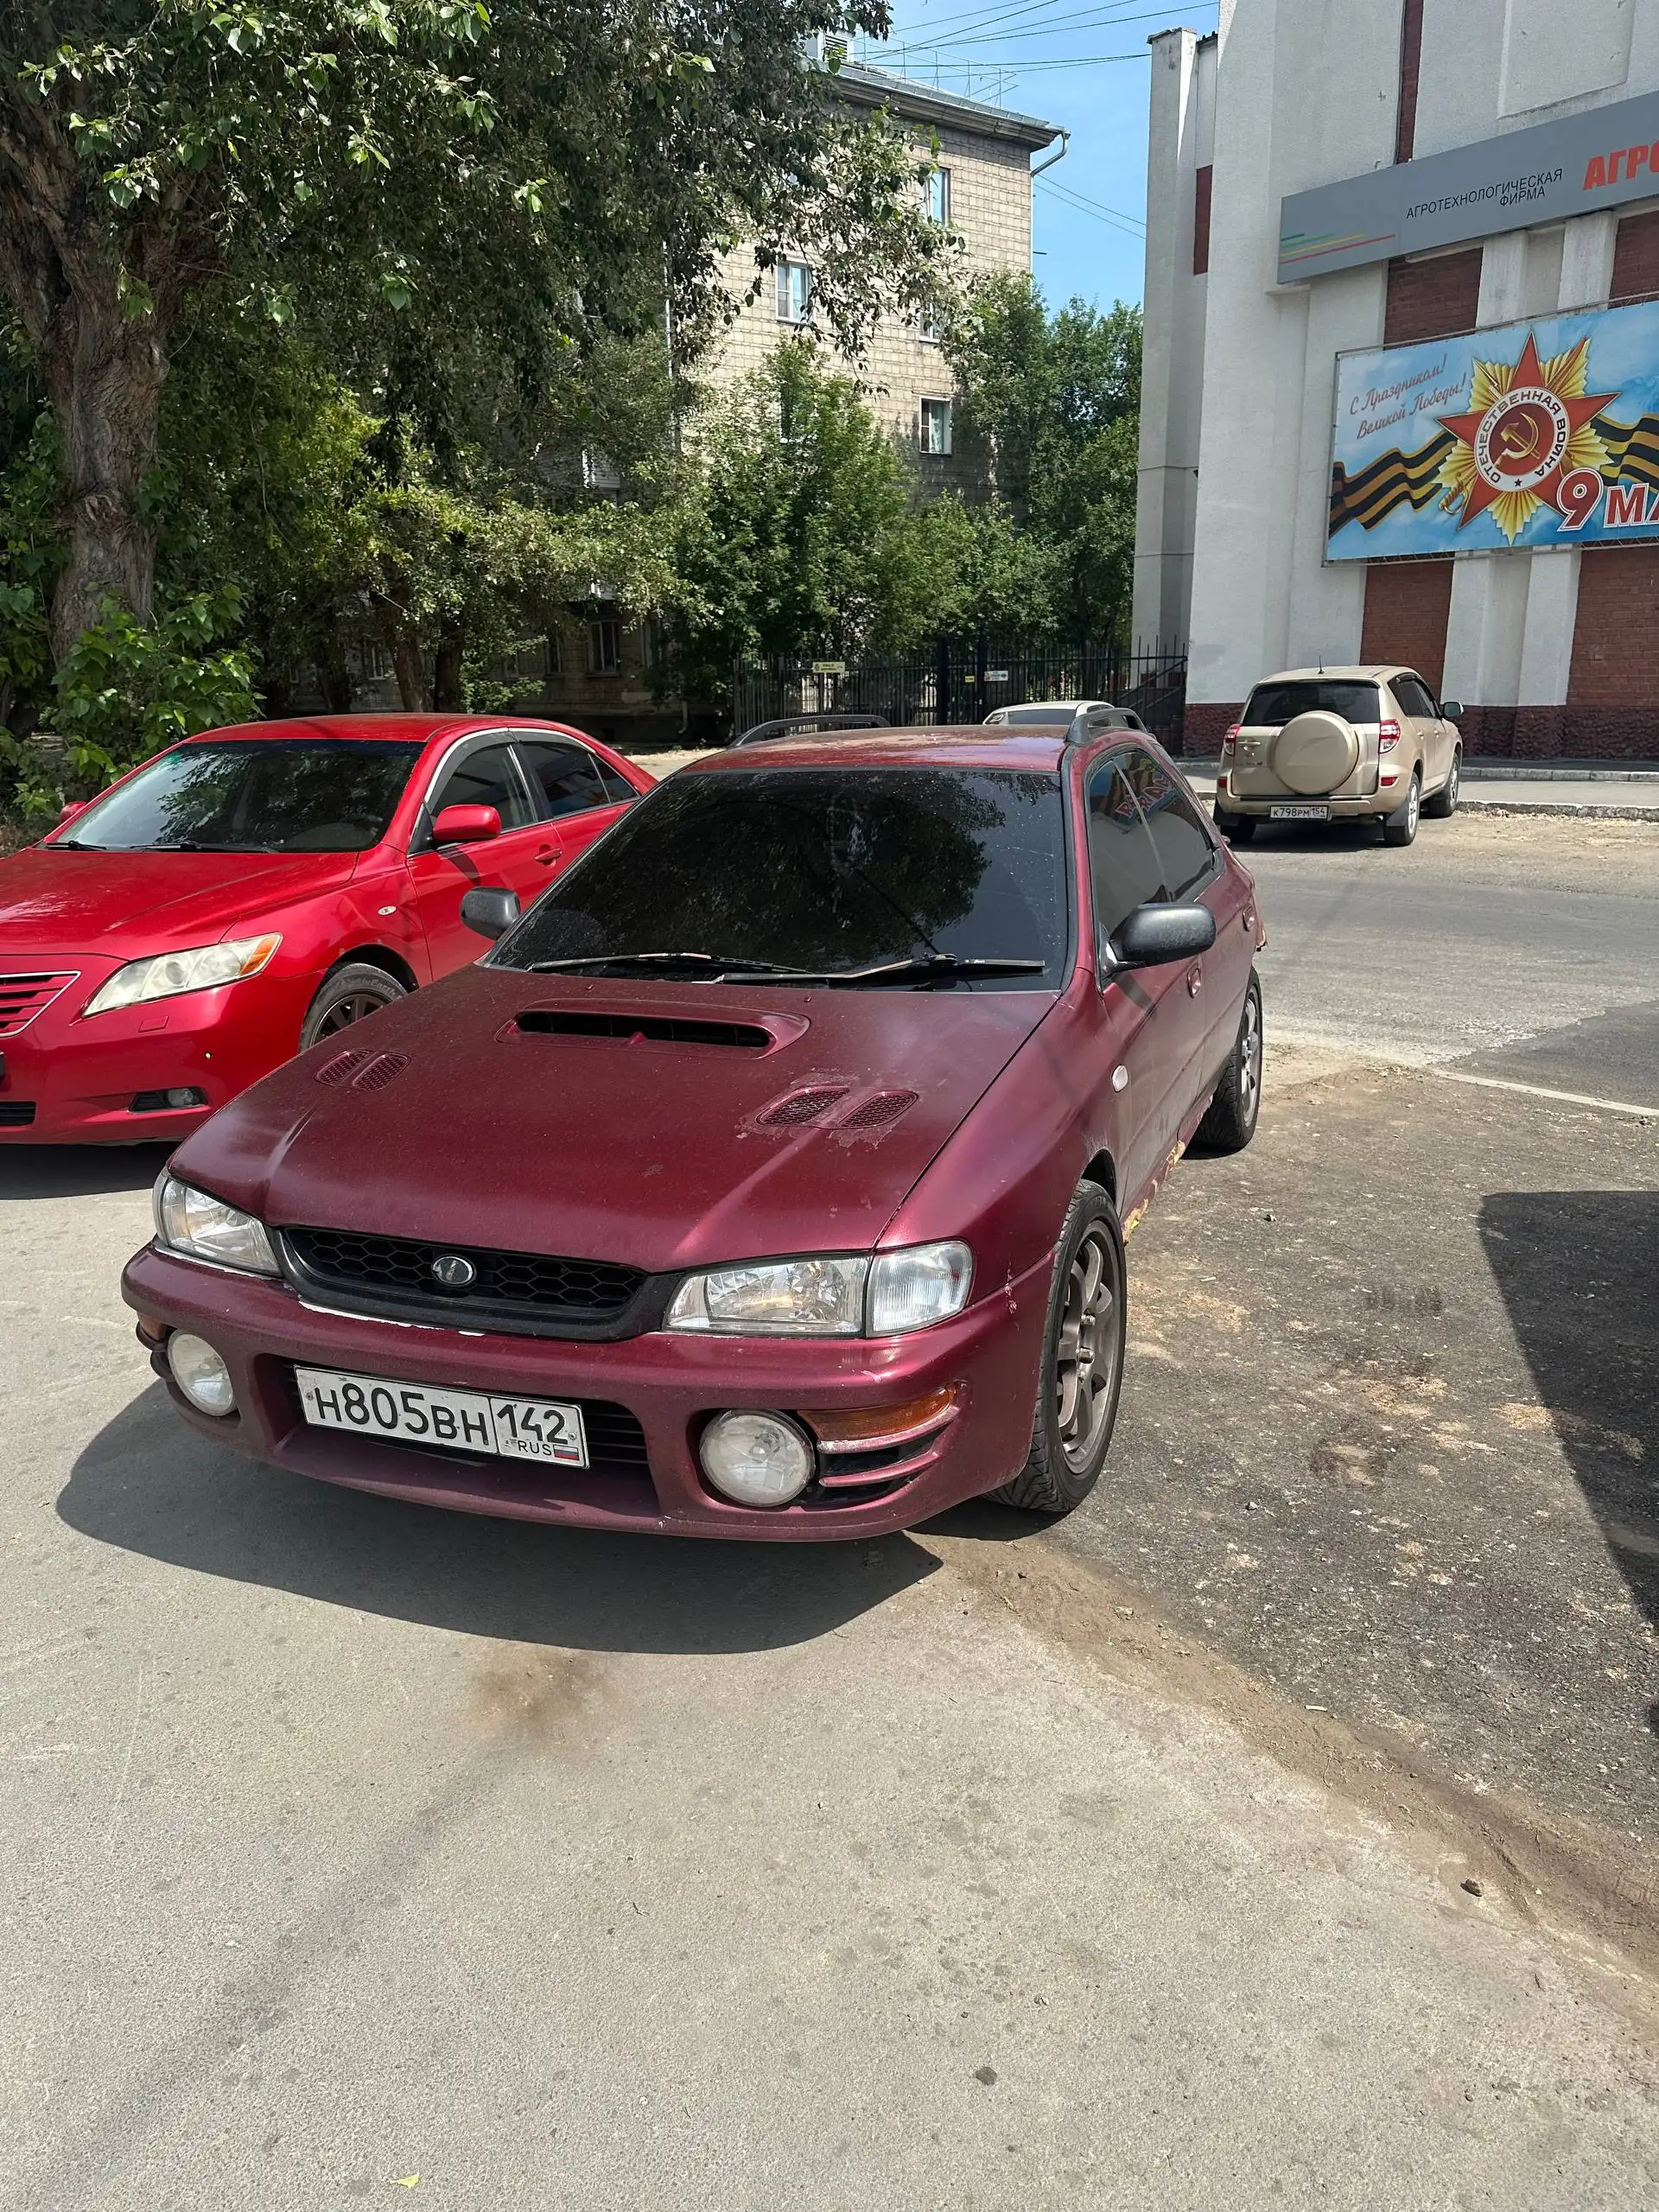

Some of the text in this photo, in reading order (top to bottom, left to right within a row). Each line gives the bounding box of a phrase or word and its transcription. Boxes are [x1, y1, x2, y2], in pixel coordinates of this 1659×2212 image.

[1406, 168, 1563, 219] АГРОТЕХНОЛОГИЧЕСКАЯ
[1499, 186, 1546, 207] ФИРМА
[1350, 353, 1448, 416] С Праздником!
[1357, 372, 1466, 440] Великой Победы!
[1478, 390, 1562, 484] ОТЕЧЕСТВЕННАЯ
[1557, 467, 1605, 531] 9
[1273, 807, 1325, 817] К798РМ 154
[315, 1382, 569, 1446] Н805ВН 142
[518, 1440, 552, 1456] RUS
